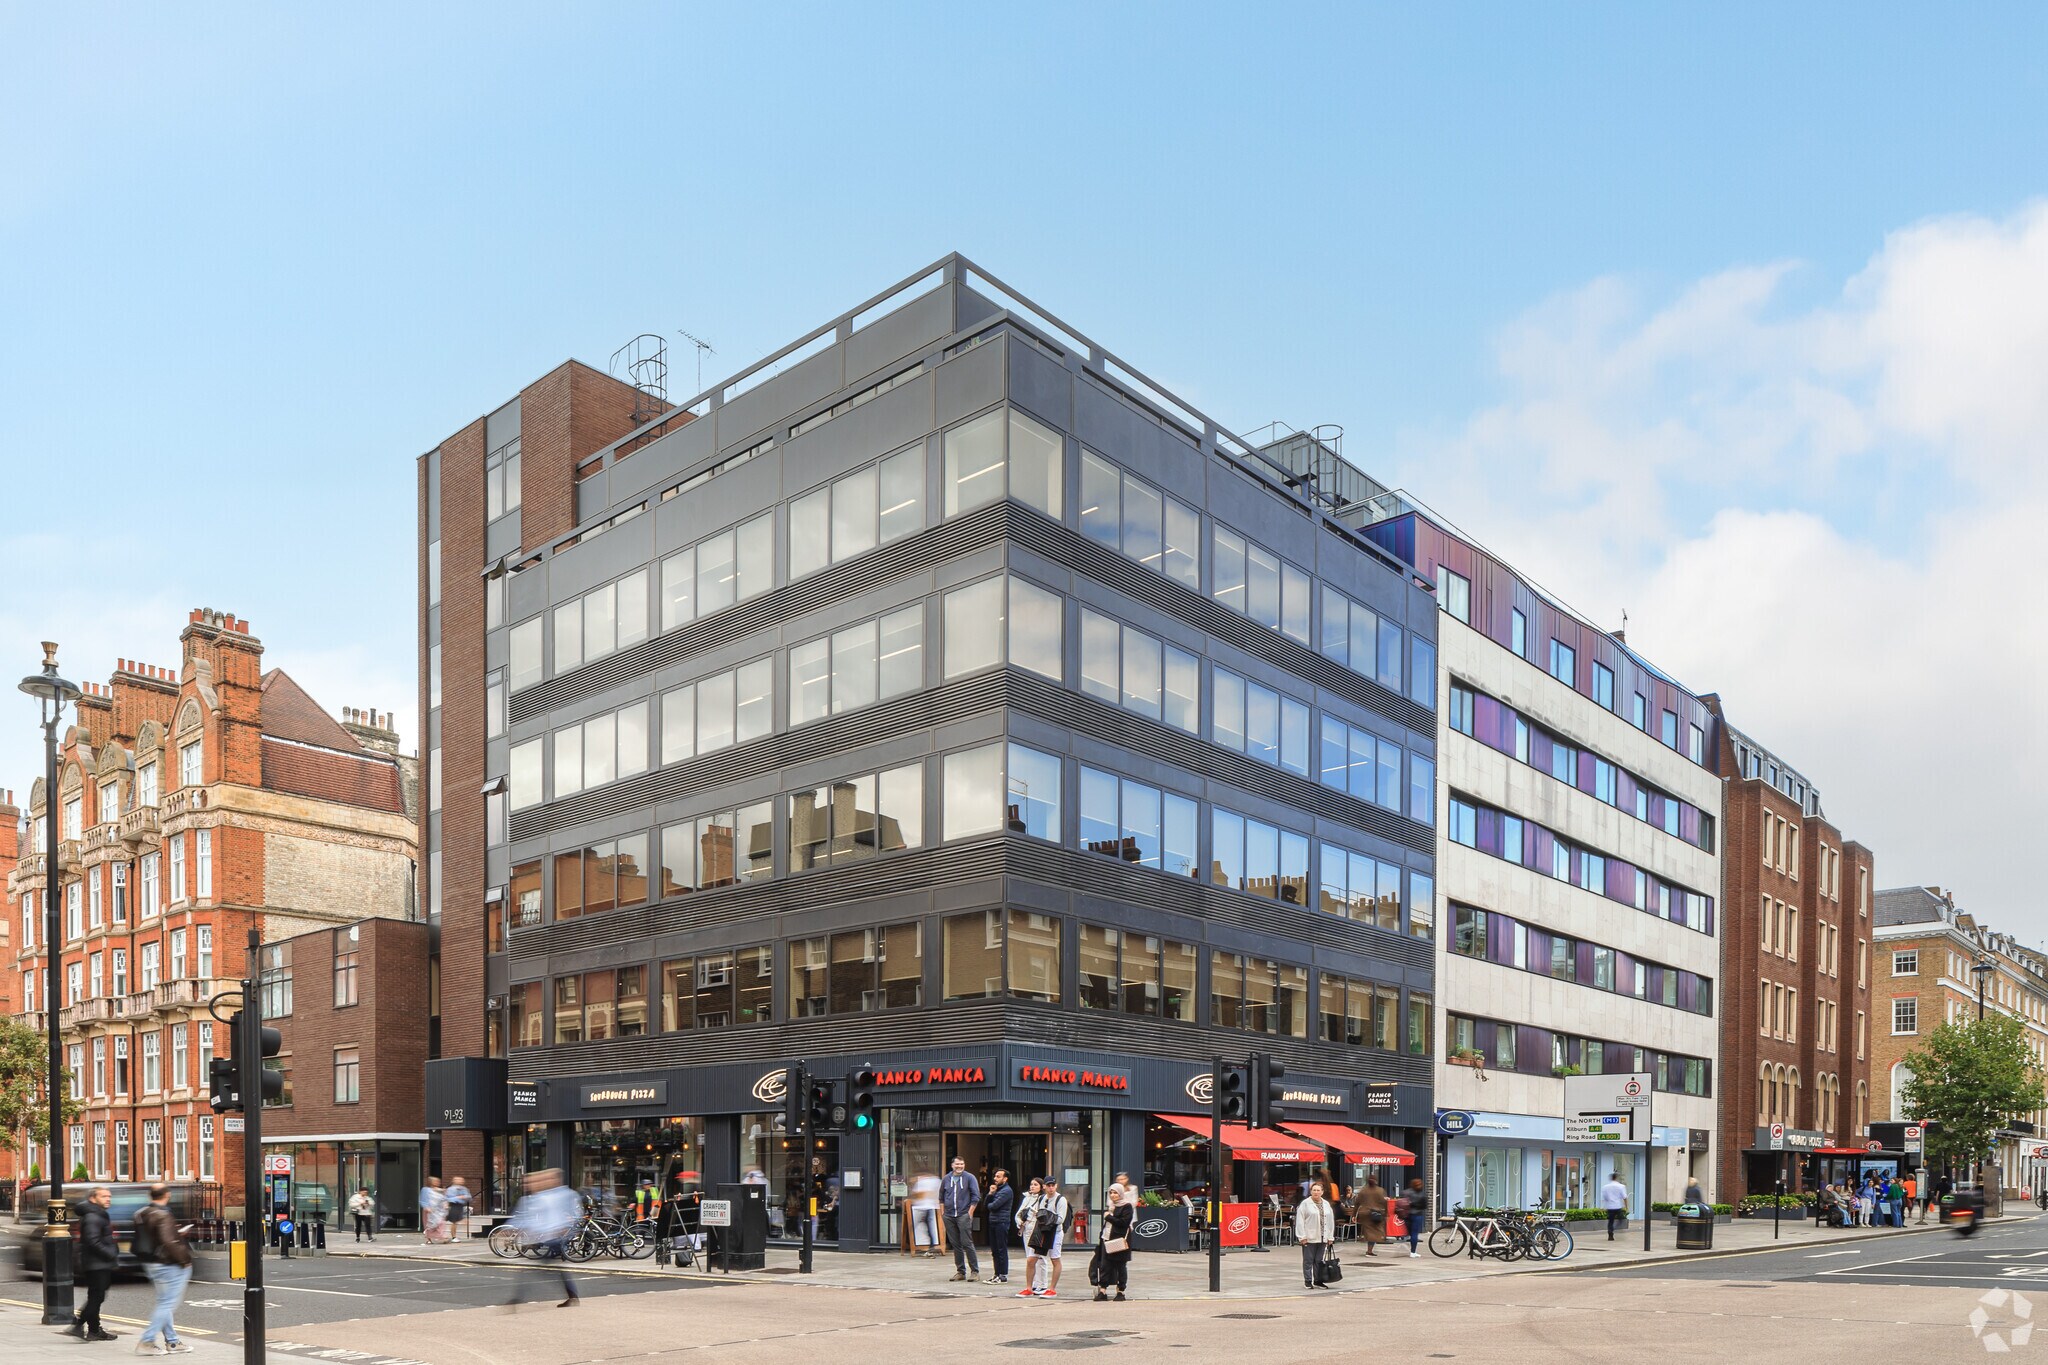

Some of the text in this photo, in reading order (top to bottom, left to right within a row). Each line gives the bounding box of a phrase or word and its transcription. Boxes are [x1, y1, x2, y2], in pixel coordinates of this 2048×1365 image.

[872, 1067, 984, 1085] RANCO MANCA
[1023, 1065, 1127, 1089] FRANCO MANCA
[631, 1088, 655, 1100] PIZZA
[1320, 1093, 1341, 1105] PIZZA
[444, 1109, 463, 1120] 91-93
[1446, 1120, 1463, 1129] HILL
[1260, 1152, 1299, 1160] FRANCO MANCA
[1362, 1156, 1386, 1164] SOURDOUGH
